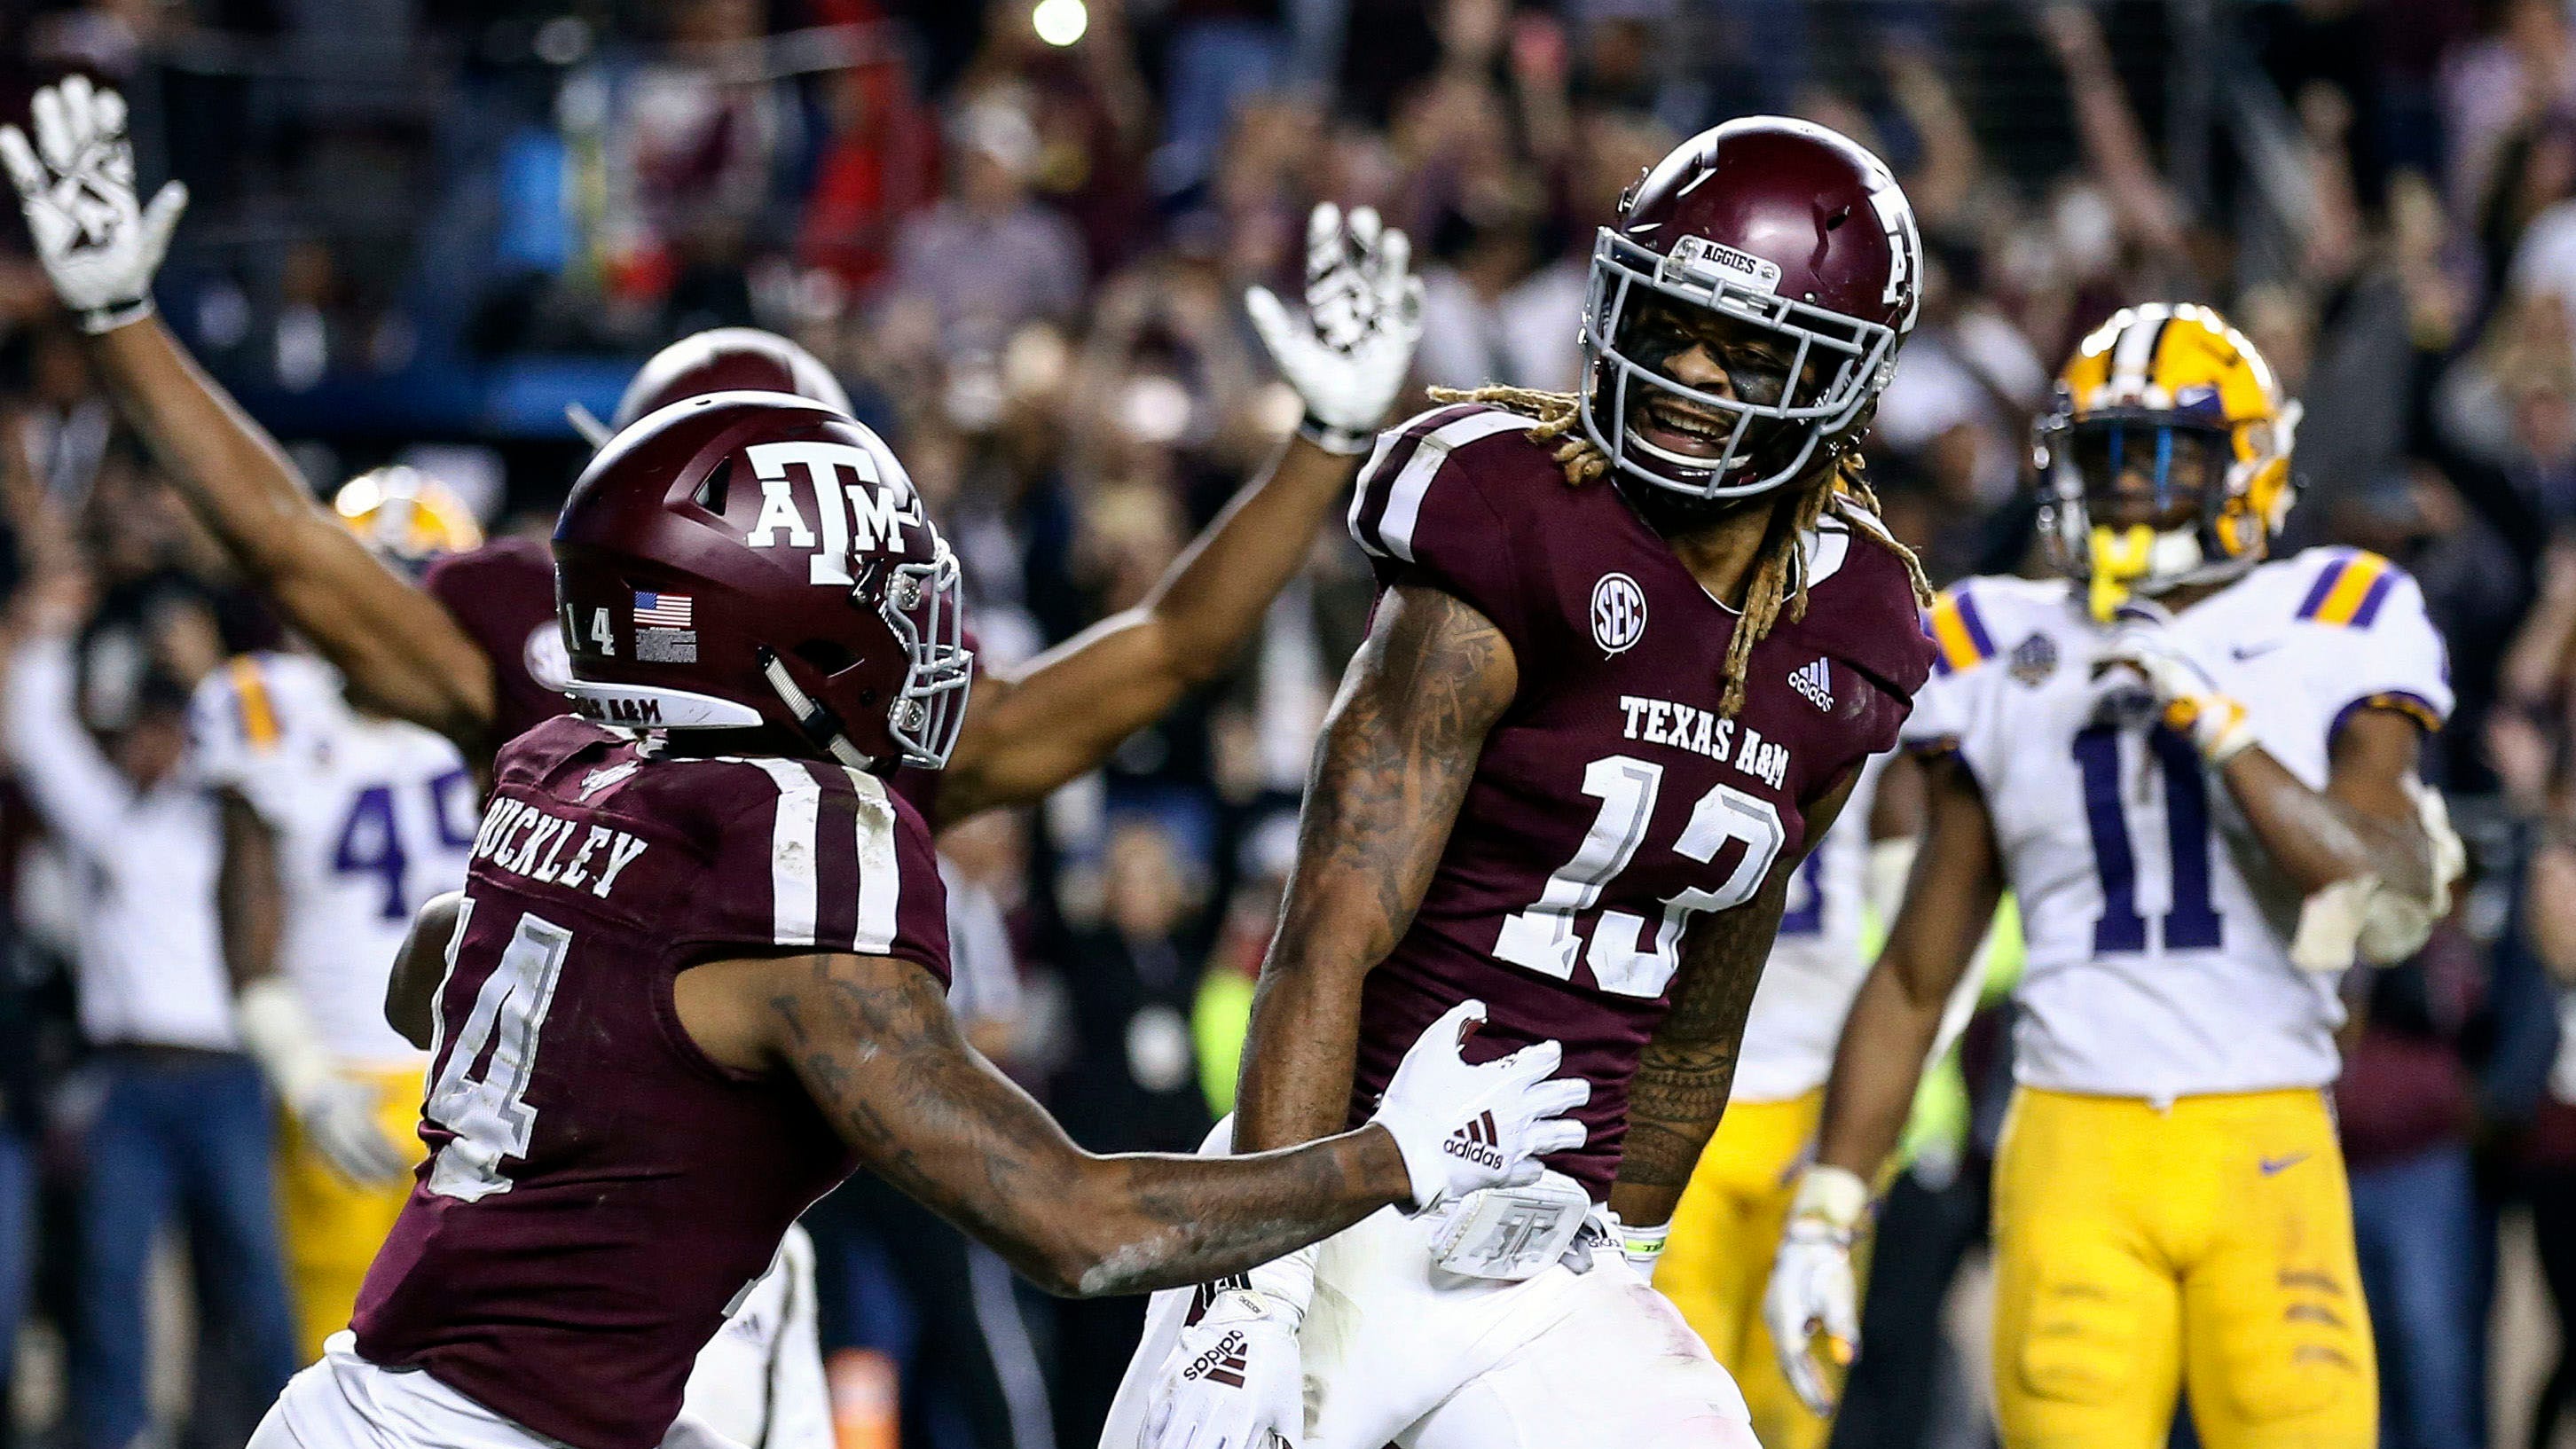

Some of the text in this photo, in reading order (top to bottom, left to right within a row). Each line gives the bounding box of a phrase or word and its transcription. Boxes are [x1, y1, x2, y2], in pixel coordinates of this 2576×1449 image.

[1701, 245, 1755, 275] AGGIES
[566, 604, 616, 656] 14
[1596, 580, 1640, 646] SEC
[1787, 671, 1834, 712] adidas
[1620, 695, 1790, 789] TEXAS A&M
[2073, 717, 2221, 952] 11
[1491, 755, 1786, 998] 13
[426, 897, 573, 1202] 4
[1443, 1137, 1503, 1170] adidas
[1183, 1330, 1244, 1381] adidas
